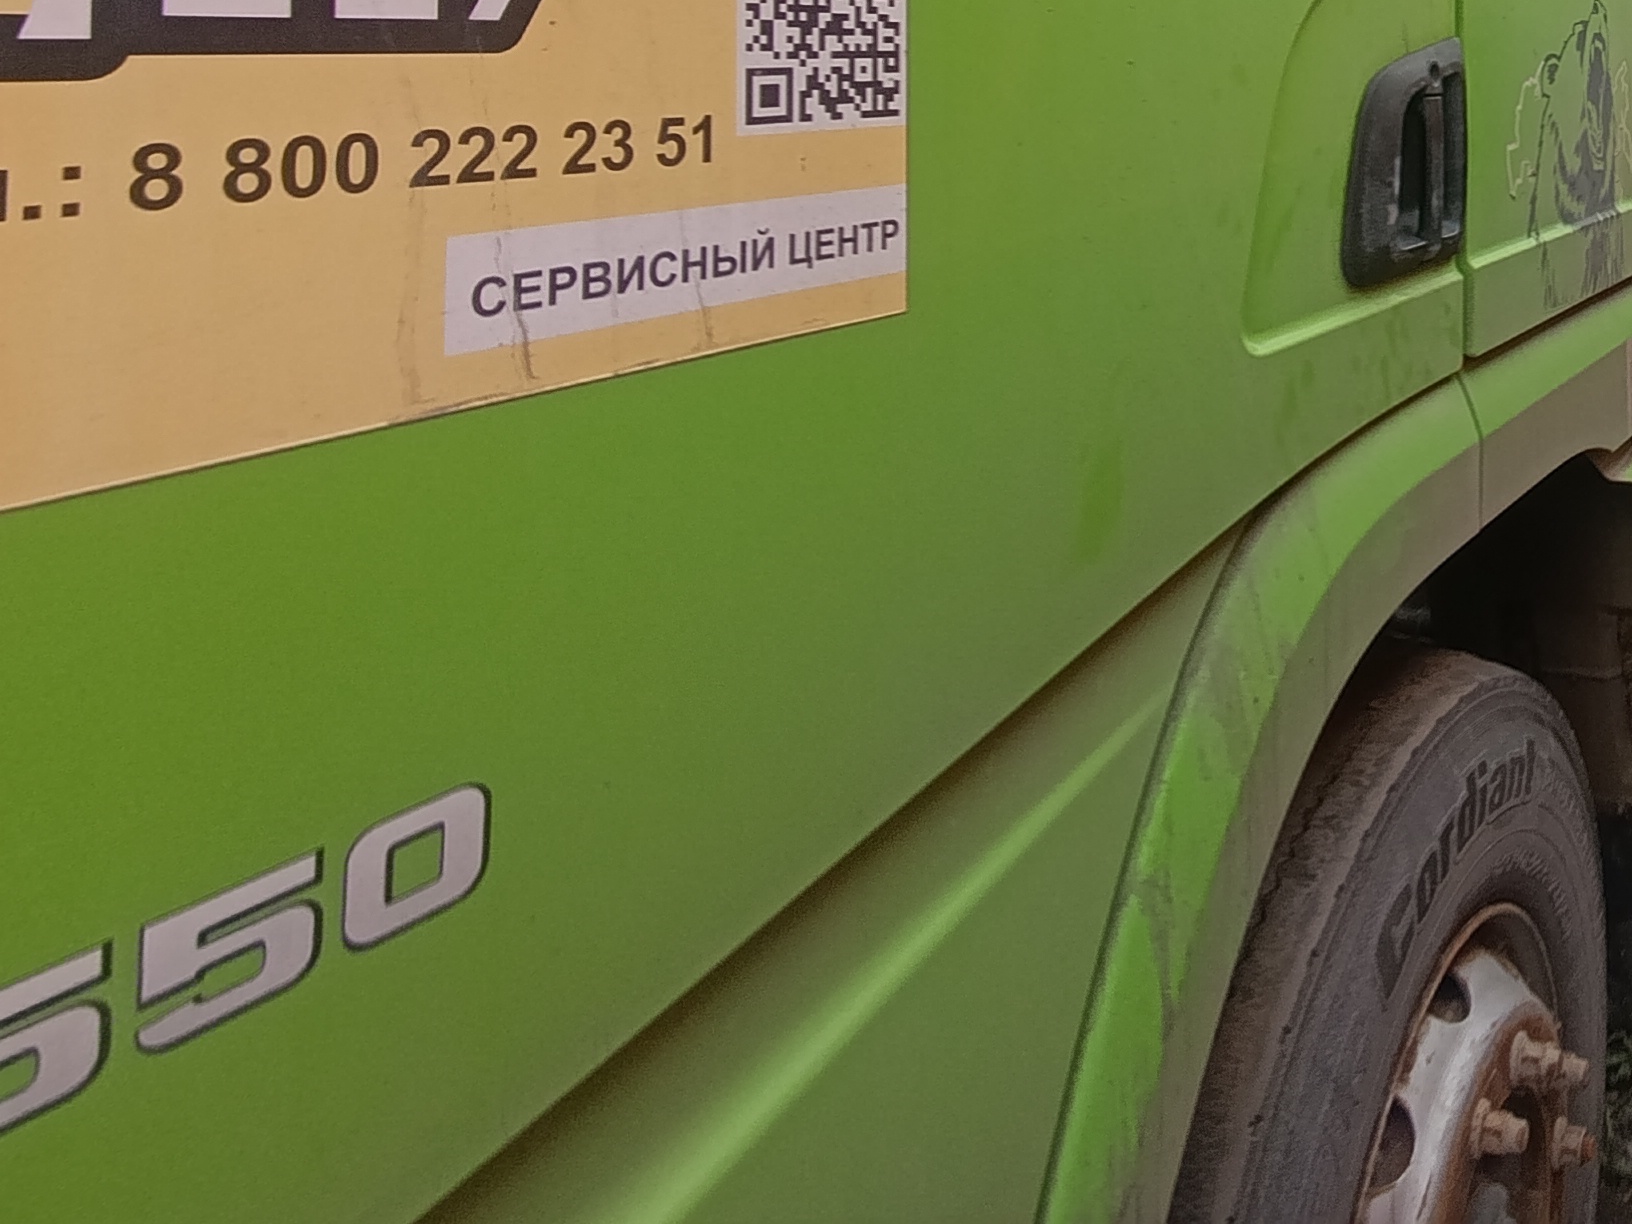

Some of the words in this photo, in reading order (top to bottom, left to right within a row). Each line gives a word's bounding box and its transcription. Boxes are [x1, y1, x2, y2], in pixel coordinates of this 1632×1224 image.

[129, 142, 184, 211] 8
[222, 132, 380, 203] 800
[409, 124, 539, 188] 222
[562, 119, 634, 176] 23
[656, 114, 713, 168] 51
[470, 228, 775, 318] СЕРВИСНЫЙ
[788, 218, 900, 269] ЦЕНТР
